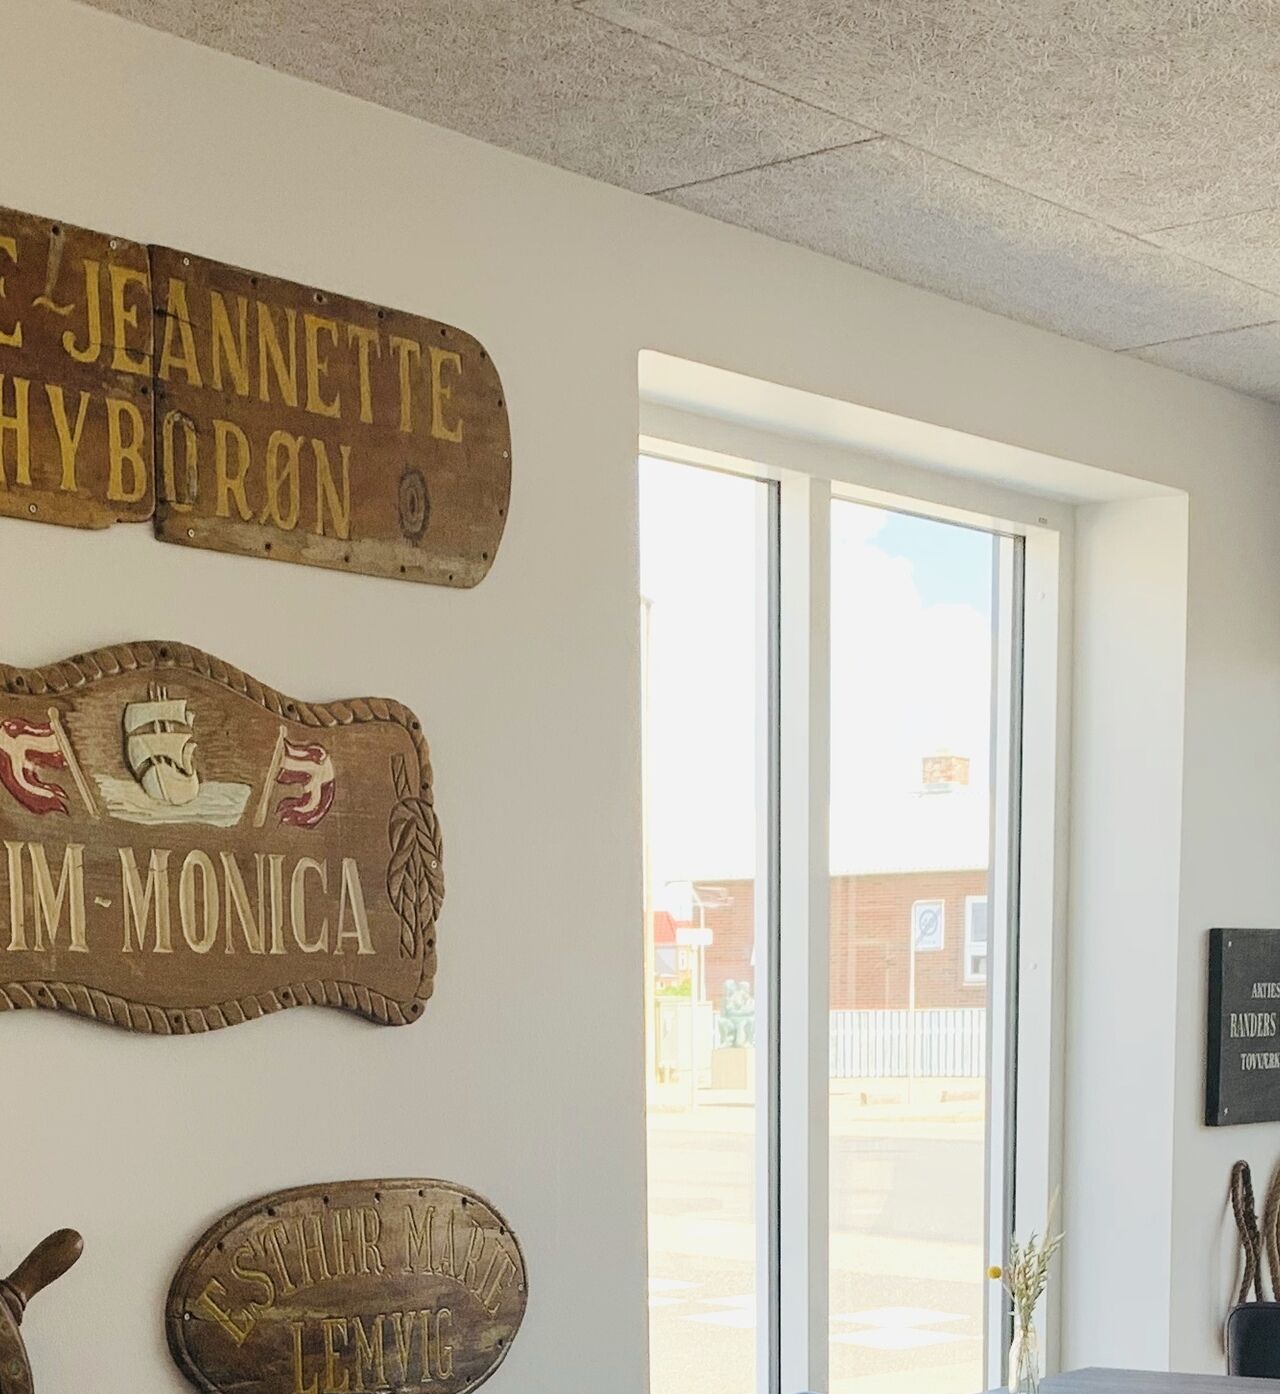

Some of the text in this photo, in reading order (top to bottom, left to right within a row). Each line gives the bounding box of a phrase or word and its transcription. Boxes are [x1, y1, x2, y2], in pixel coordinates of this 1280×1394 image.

[1230, 1011, 1277, 1039] RANDERS
[195, 1203, 518, 1348] ESTHER MARIE
